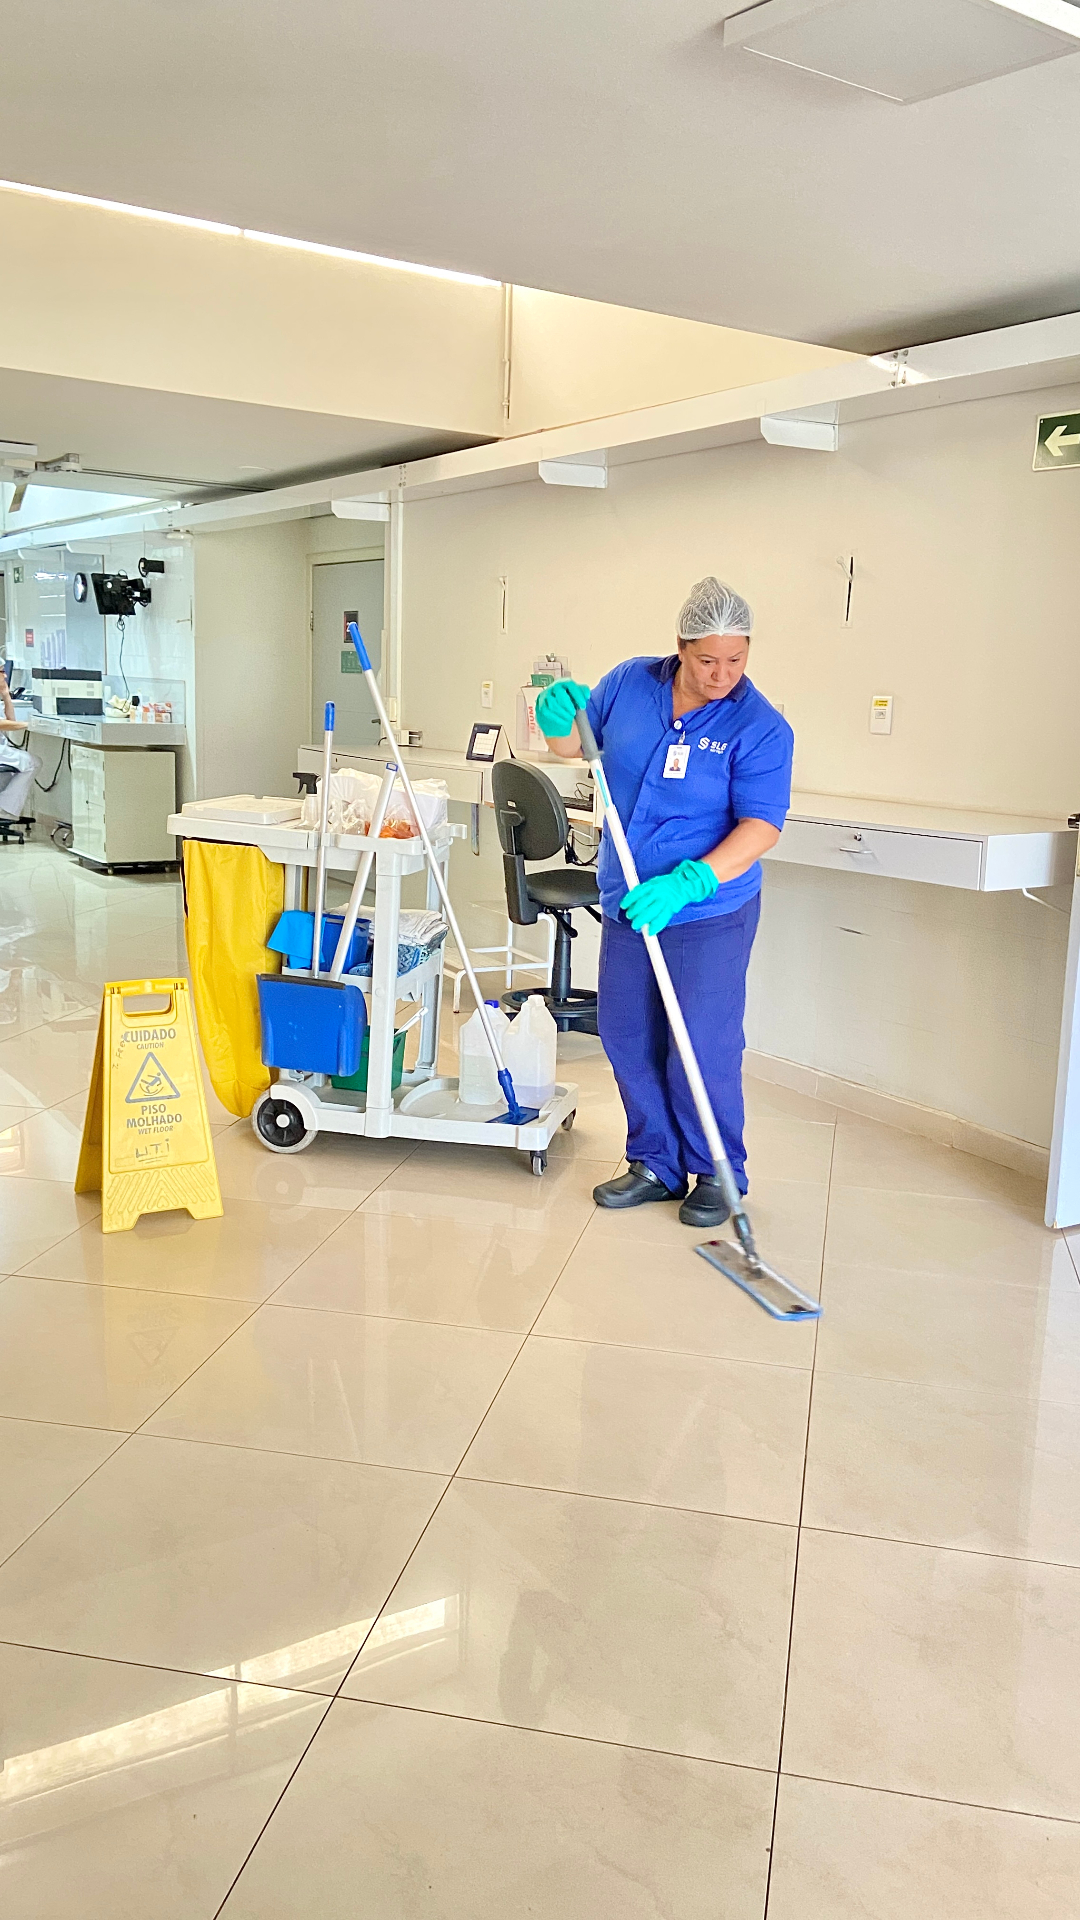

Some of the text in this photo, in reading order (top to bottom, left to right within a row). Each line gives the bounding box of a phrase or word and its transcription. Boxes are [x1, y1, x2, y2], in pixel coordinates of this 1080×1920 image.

[123, 1028, 177, 1043] CUIDADO
[136, 1042, 165, 1050] CAUTION
[141, 1103, 167, 1115] PISO
[126, 1113, 183, 1129] MOLHADO
[138, 1125, 174, 1135] WET FLOOR
